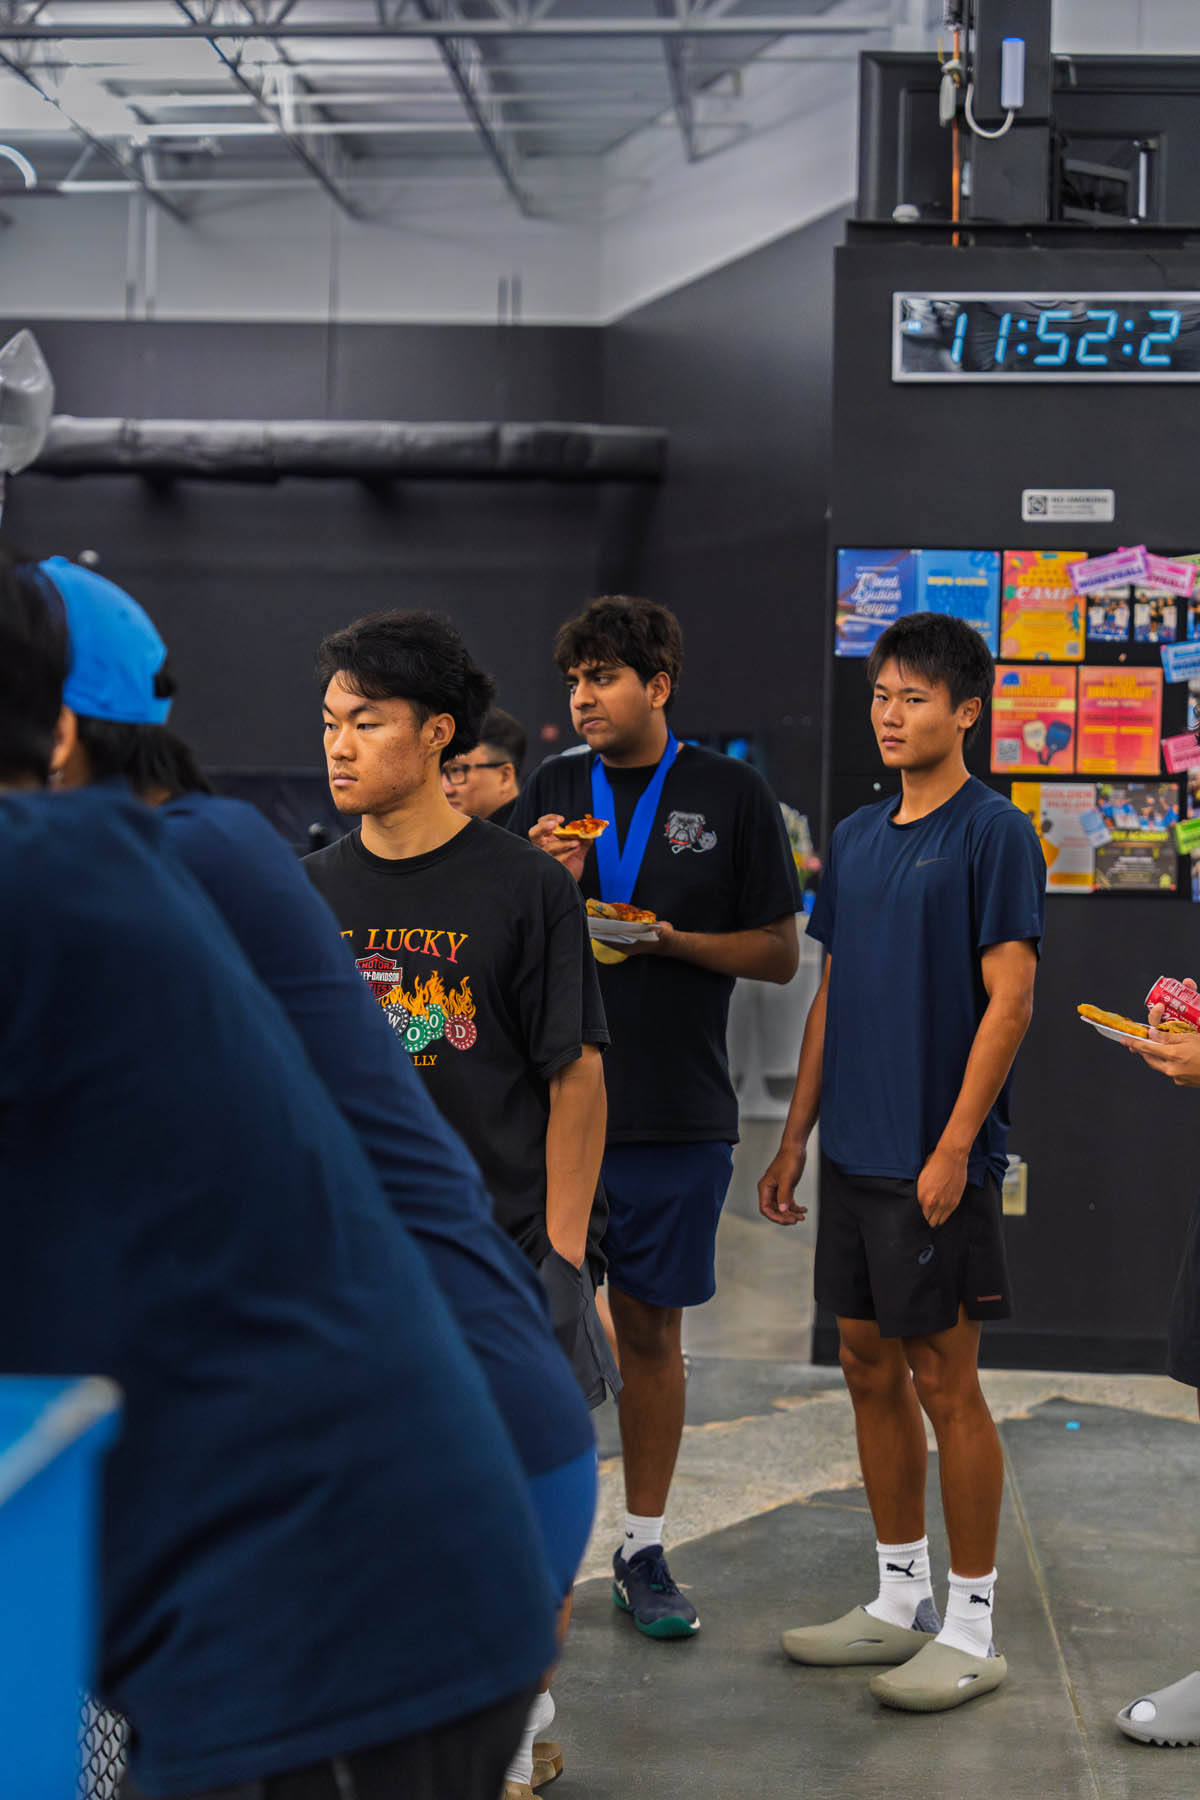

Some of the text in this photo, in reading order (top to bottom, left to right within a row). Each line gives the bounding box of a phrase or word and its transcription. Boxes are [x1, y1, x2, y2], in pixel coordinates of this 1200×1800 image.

[364, 928, 468, 964] LUCKY
[362, 959, 390, 970] MOTOR
[361, 971, 400, 982] EY-DAVIDSON
[413, 1055, 438, 1066] LLY
